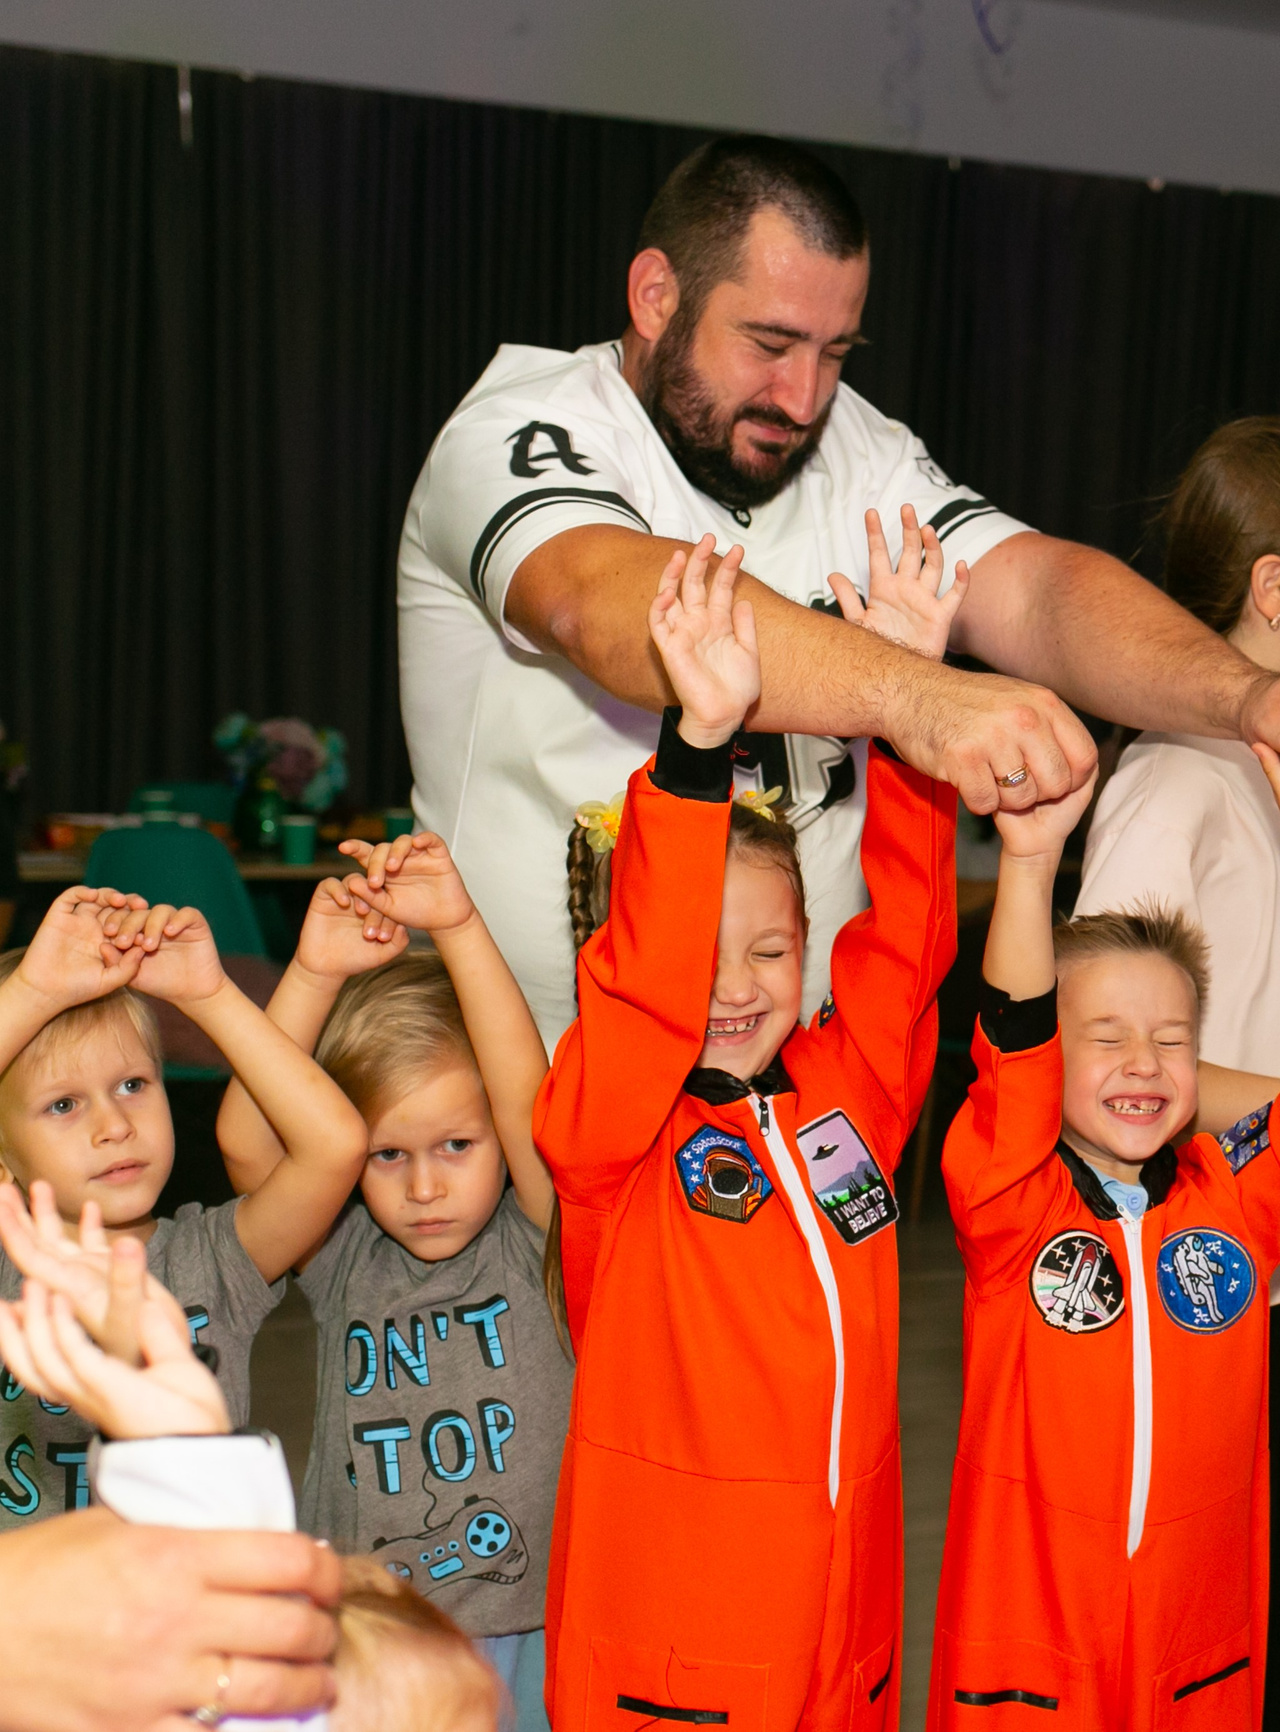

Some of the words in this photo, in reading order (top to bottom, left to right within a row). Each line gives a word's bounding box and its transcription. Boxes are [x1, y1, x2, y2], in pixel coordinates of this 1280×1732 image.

[833, 1210, 843, 1223] I
[840, 1193, 871, 1219] WANT
[869, 1186, 885, 1203] TO
[848, 1202, 888, 1234] BELIEVE
[345, 1397, 516, 1495] TOP
